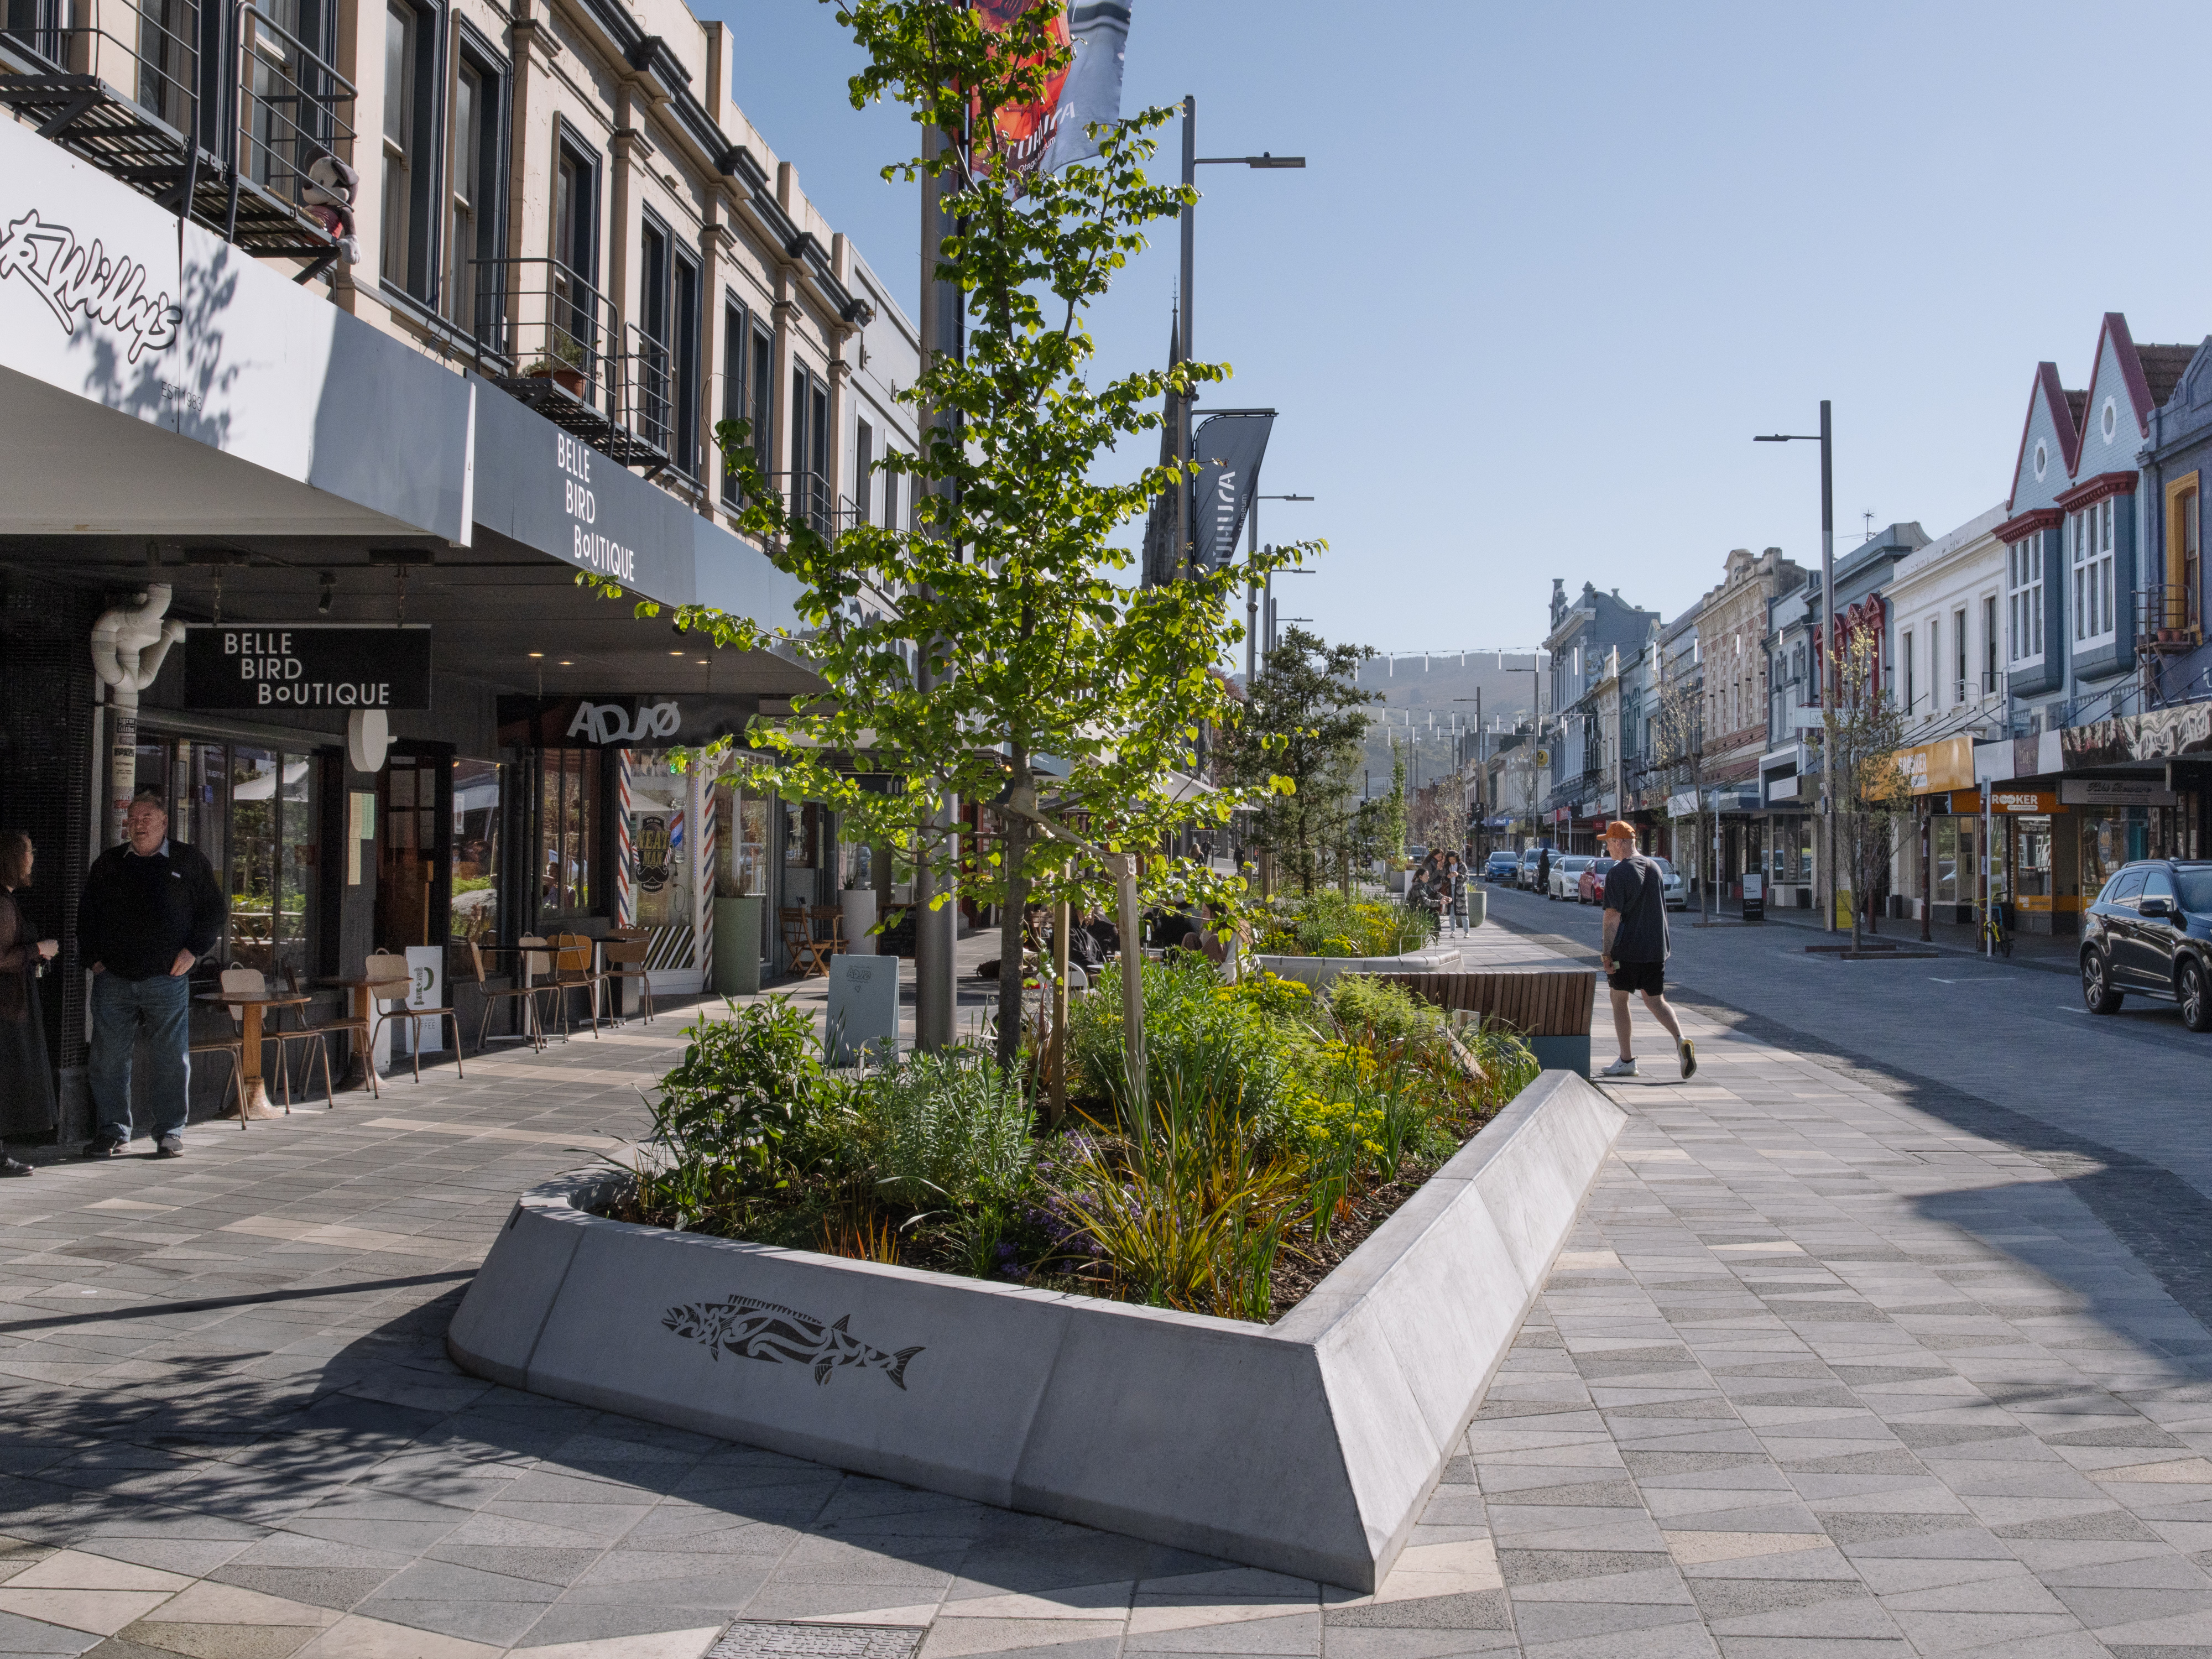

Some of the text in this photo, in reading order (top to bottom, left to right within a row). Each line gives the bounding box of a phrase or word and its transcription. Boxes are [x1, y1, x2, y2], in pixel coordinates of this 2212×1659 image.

[1018, 137, 1056, 174] Otago Museum
[161, 381, 202, 412] EST 1983
[557, 432, 590, 484] BELLE
[565, 478, 596, 524] BIRD
[225, 633, 293, 655] BELLE
[241, 658, 302, 680] BIRD
[1991, 795, 2038, 805] ROOKER
[637, 830, 671, 851] NEAT
[643, 851, 664, 865] MAN
